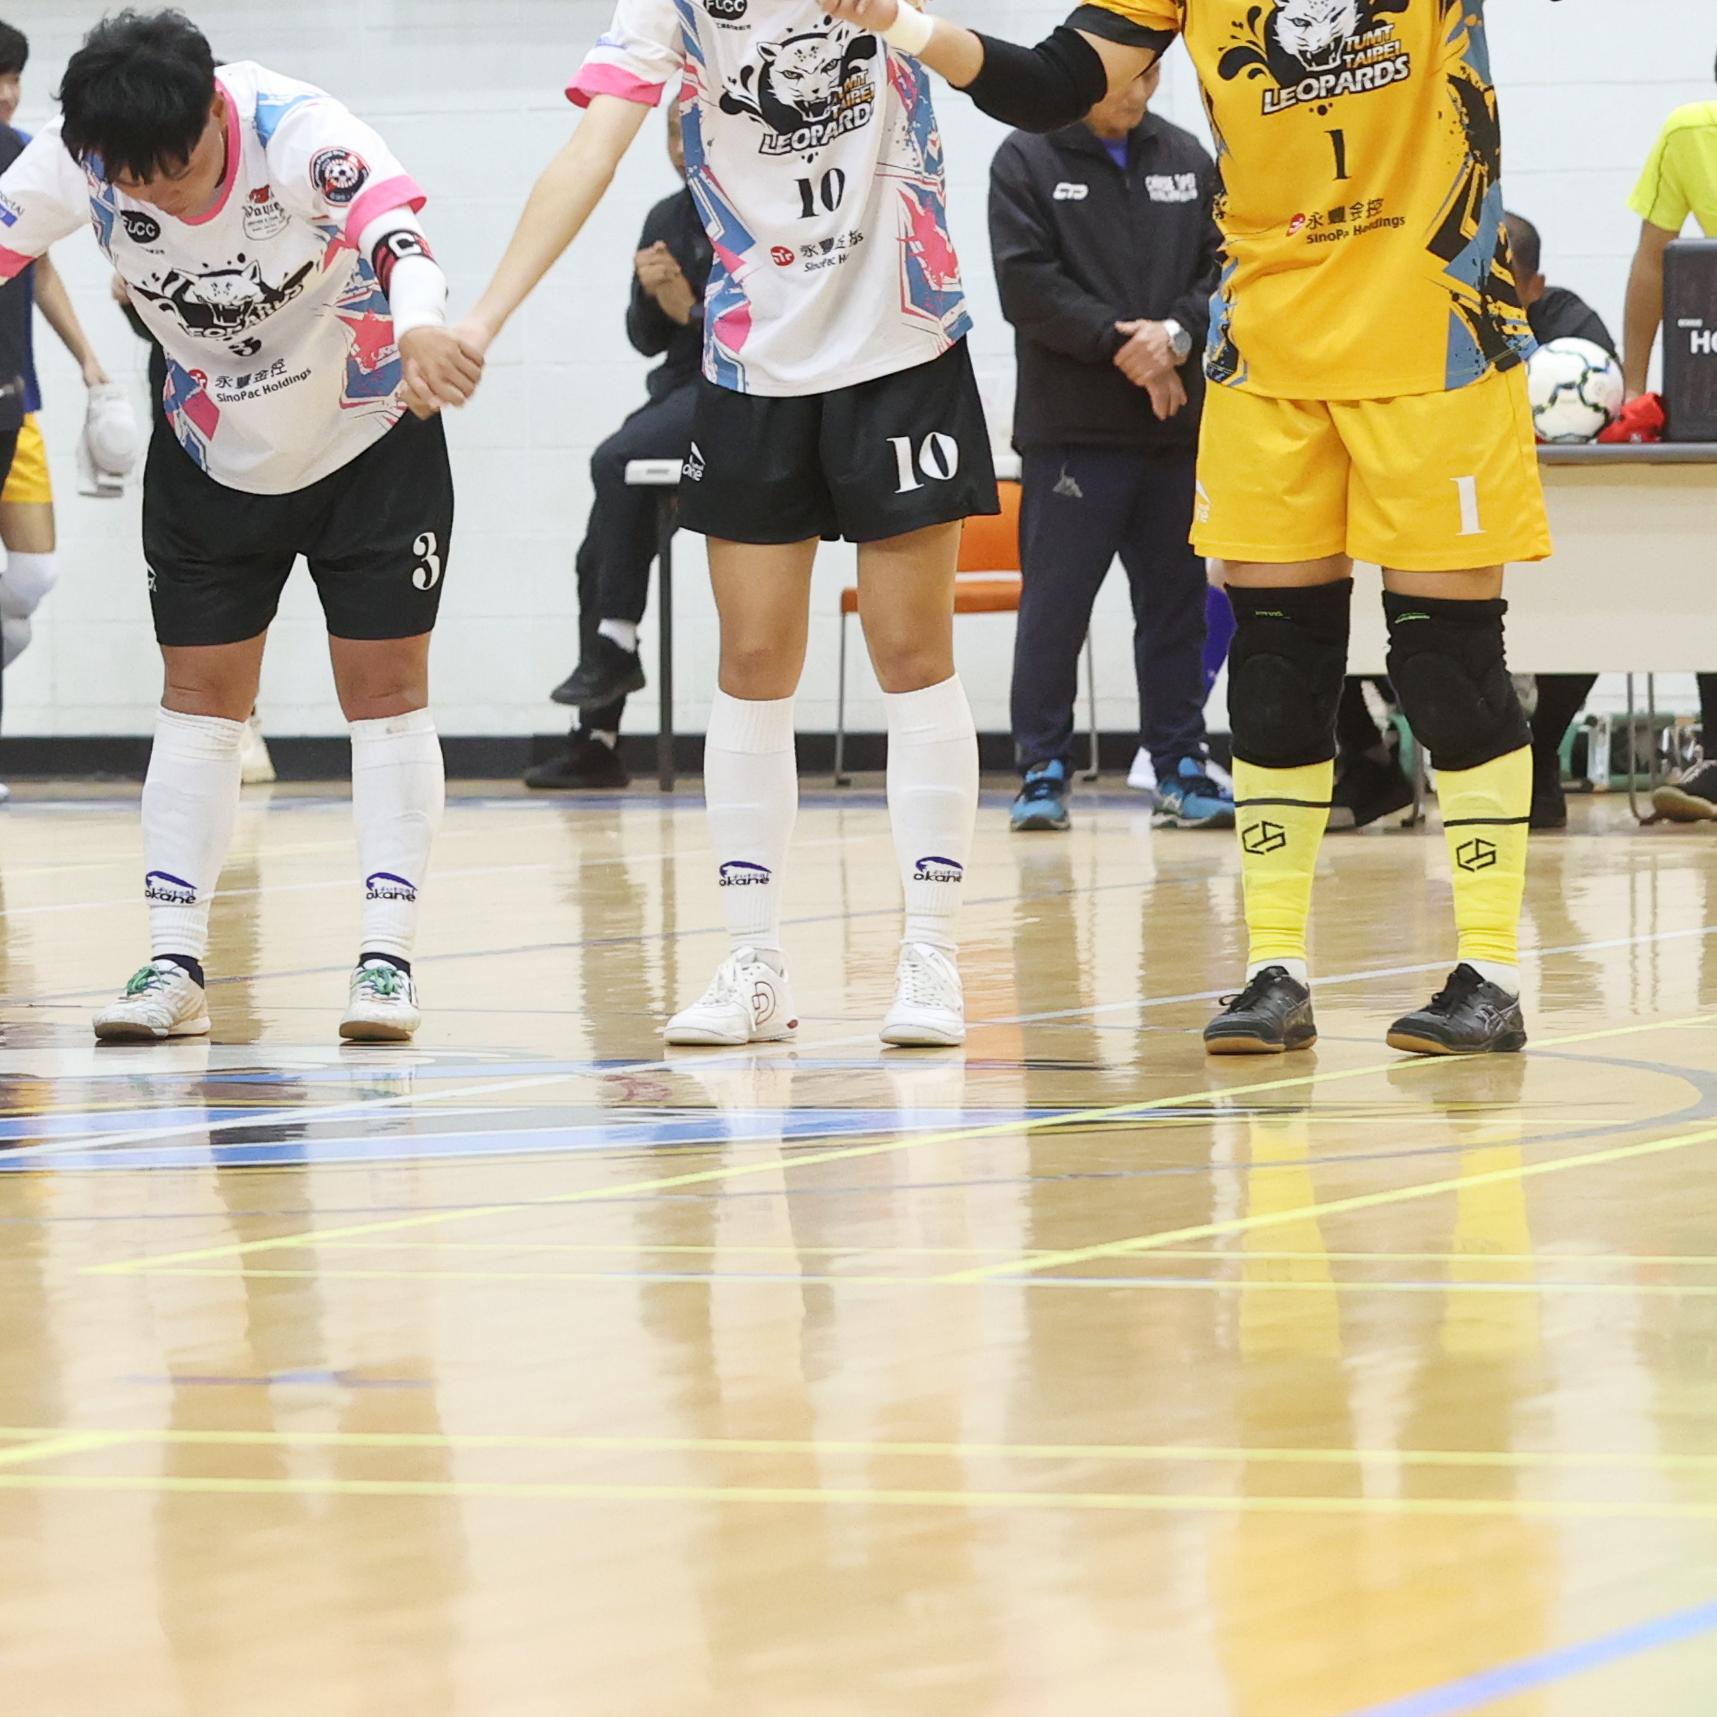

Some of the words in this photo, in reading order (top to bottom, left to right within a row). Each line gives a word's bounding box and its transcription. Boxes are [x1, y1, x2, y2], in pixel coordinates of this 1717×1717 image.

[1342, 40, 1401, 68] TAIPEI
[1345, 24, 1395, 52] TUMT
[1261, 53, 1410, 115] LEOPARDS
[1323, 128, 1353, 181] 1
[793, 167, 846, 220] 10
[388, 231, 424, 259] C
[216, 387, 262, 404] SinoPac
[262, 367, 313, 395] Holdings
[887, 431, 959, 493] 10
[1448, 474, 1487, 537] 1
[411, 531, 442, 591] 3
[719, 875, 769, 887] okane
[913, 871, 963, 883] okane
[146, 889, 197, 905] okane
[366, 889, 416, 903] okane
